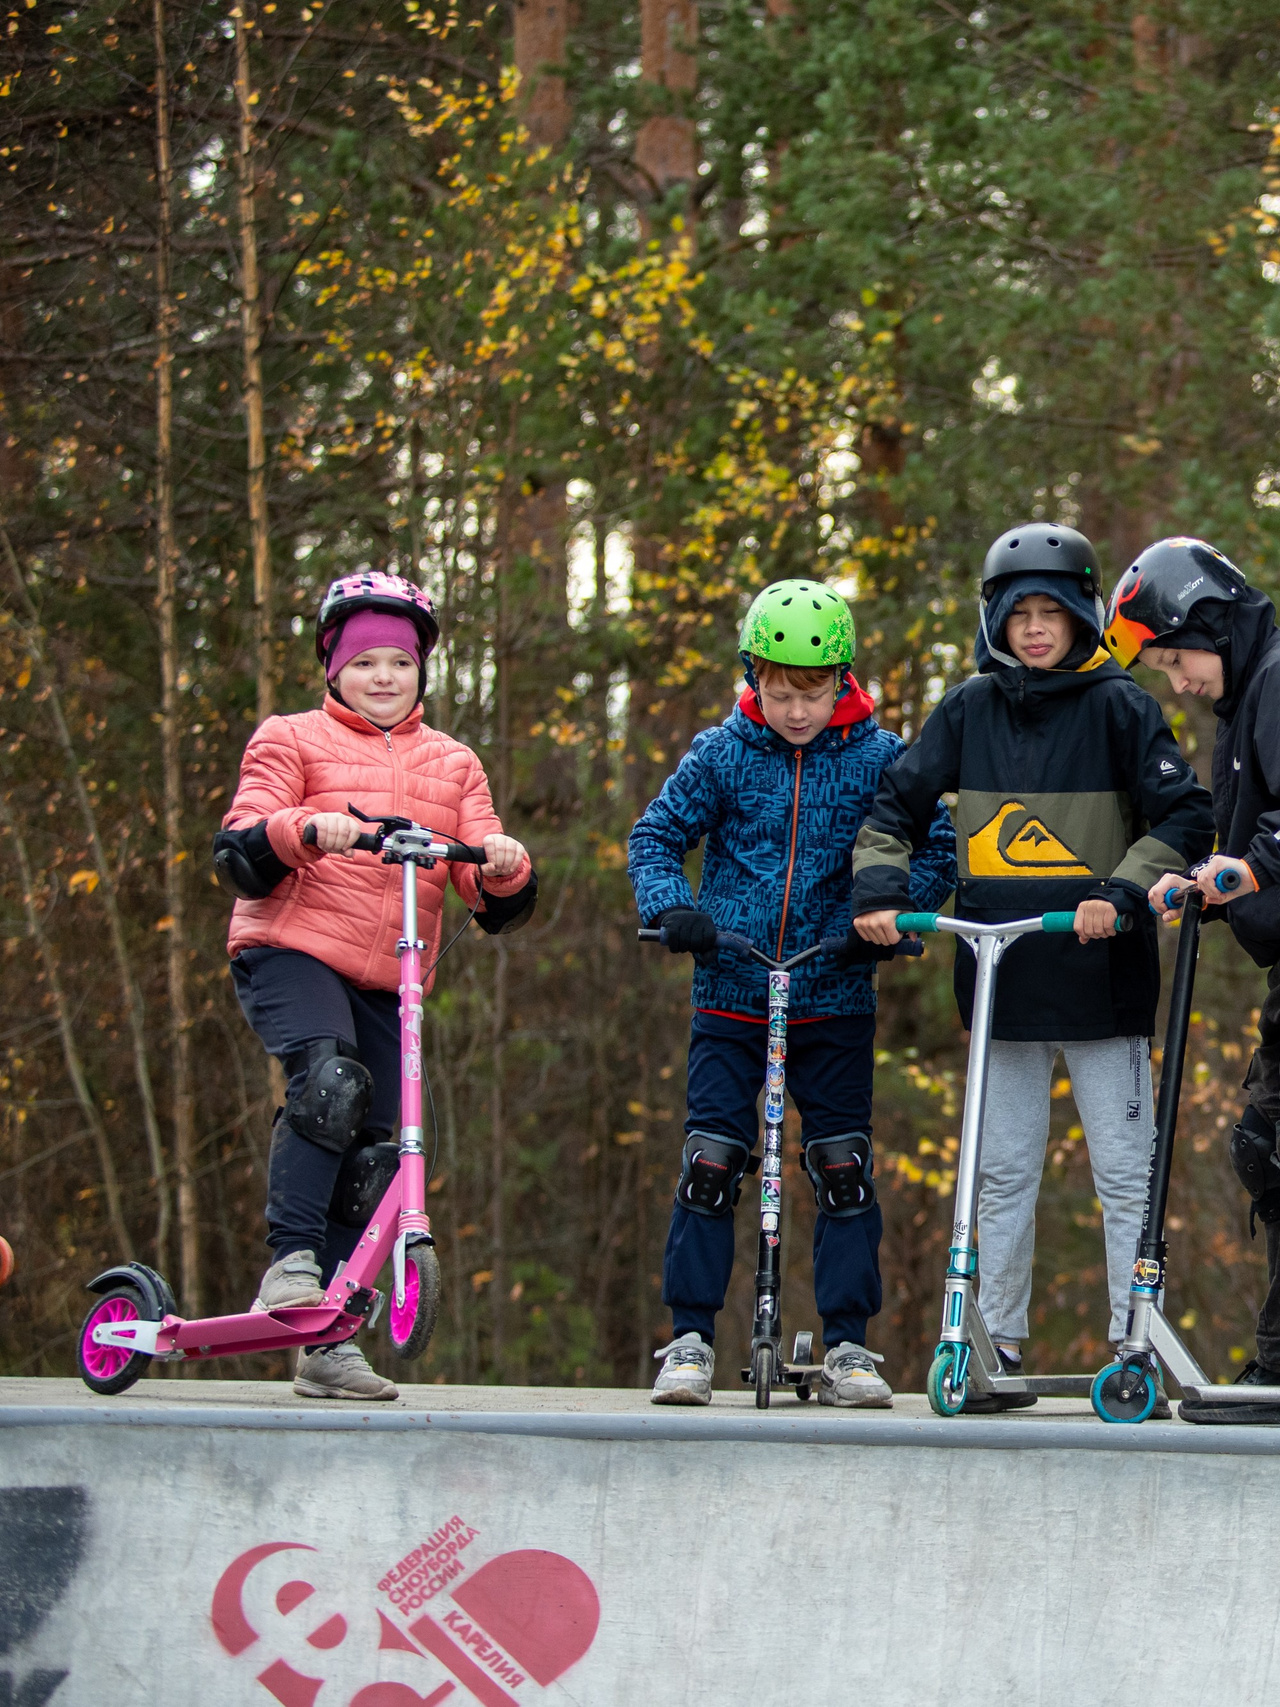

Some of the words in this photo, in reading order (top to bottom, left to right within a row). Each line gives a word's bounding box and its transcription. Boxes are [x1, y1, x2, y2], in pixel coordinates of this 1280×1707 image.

[1129, 1104, 1140, 1118] 79
[377, 1515, 466, 1592] ФЕДЕРАЦИЯ
[388, 1526, 481, 1605] СНОУБОРДА
[399, 1559, 466, 1617] РОССИИ
[443, 1610, 526, 1689] КАРЕЛИЯ
